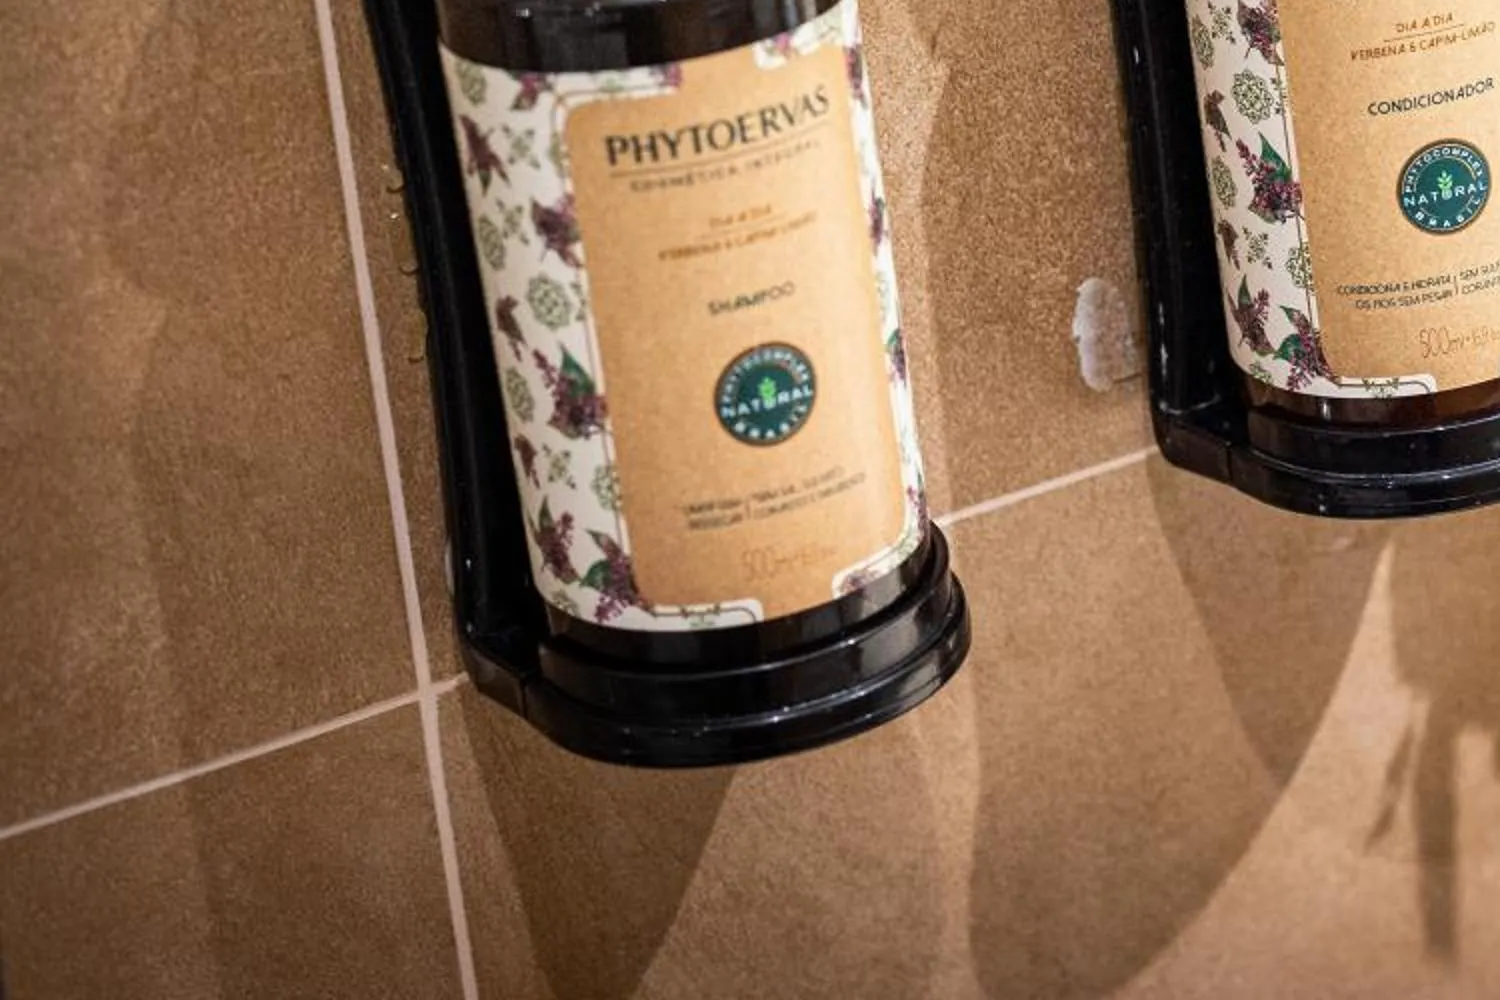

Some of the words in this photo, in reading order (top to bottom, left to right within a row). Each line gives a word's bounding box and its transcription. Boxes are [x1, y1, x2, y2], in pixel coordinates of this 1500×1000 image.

[1395, 18, 1417, 33] DIA
[1421, 16, 1431, 28] A
[1433, 12, 1454, 26] DIA
[1367, 77, 1495, 117] CONDICIONADOR
[604, 84, 830, 168] PHYTOERVAS
[1403, 181, 1488, 207] NATURAL
